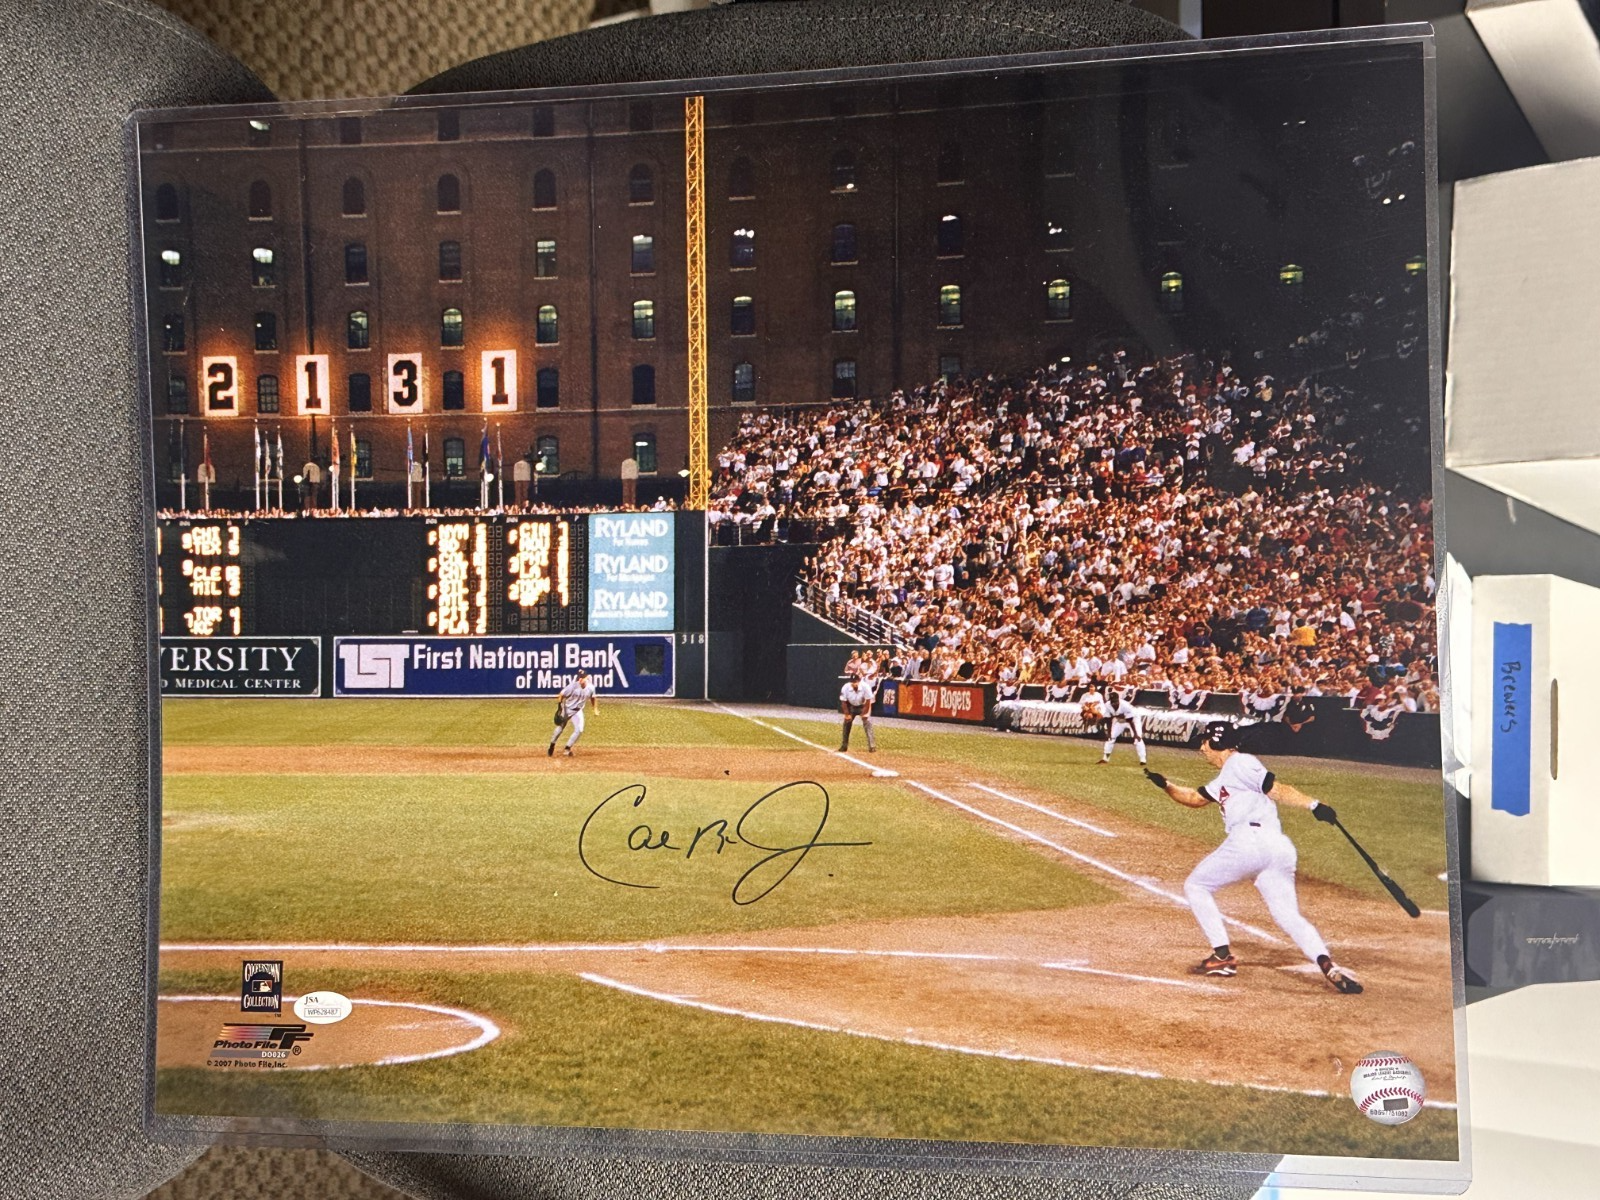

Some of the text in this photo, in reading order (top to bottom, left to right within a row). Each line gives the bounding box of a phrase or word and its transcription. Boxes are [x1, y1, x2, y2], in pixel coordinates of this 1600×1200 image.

[207, 356, 509, 411] 2 1 3 1
[594, 517, 668, 538] RYLAND
[193, 566, 222, 581] CLE
[594, 553, 668, 574] RYLAND
[593, 589, 668, 610] RYLAND
[681, 634, 705, 645] 318
[413, 643, 628, 682] First National Bank
[175, 678, 238, 689] MEDICAL
[244, 678, 301, 689] CENTER
[516, 670, 533, 689] of
[922, 685, 972, 717] Roy Rogers
[1500, 661, 1522, 733] Brewers
[243, 994, 279, 1009] COLLECTION
[304, 996, 319, 1005] JSA
[213, 1040, 279, 1049] Photo File
